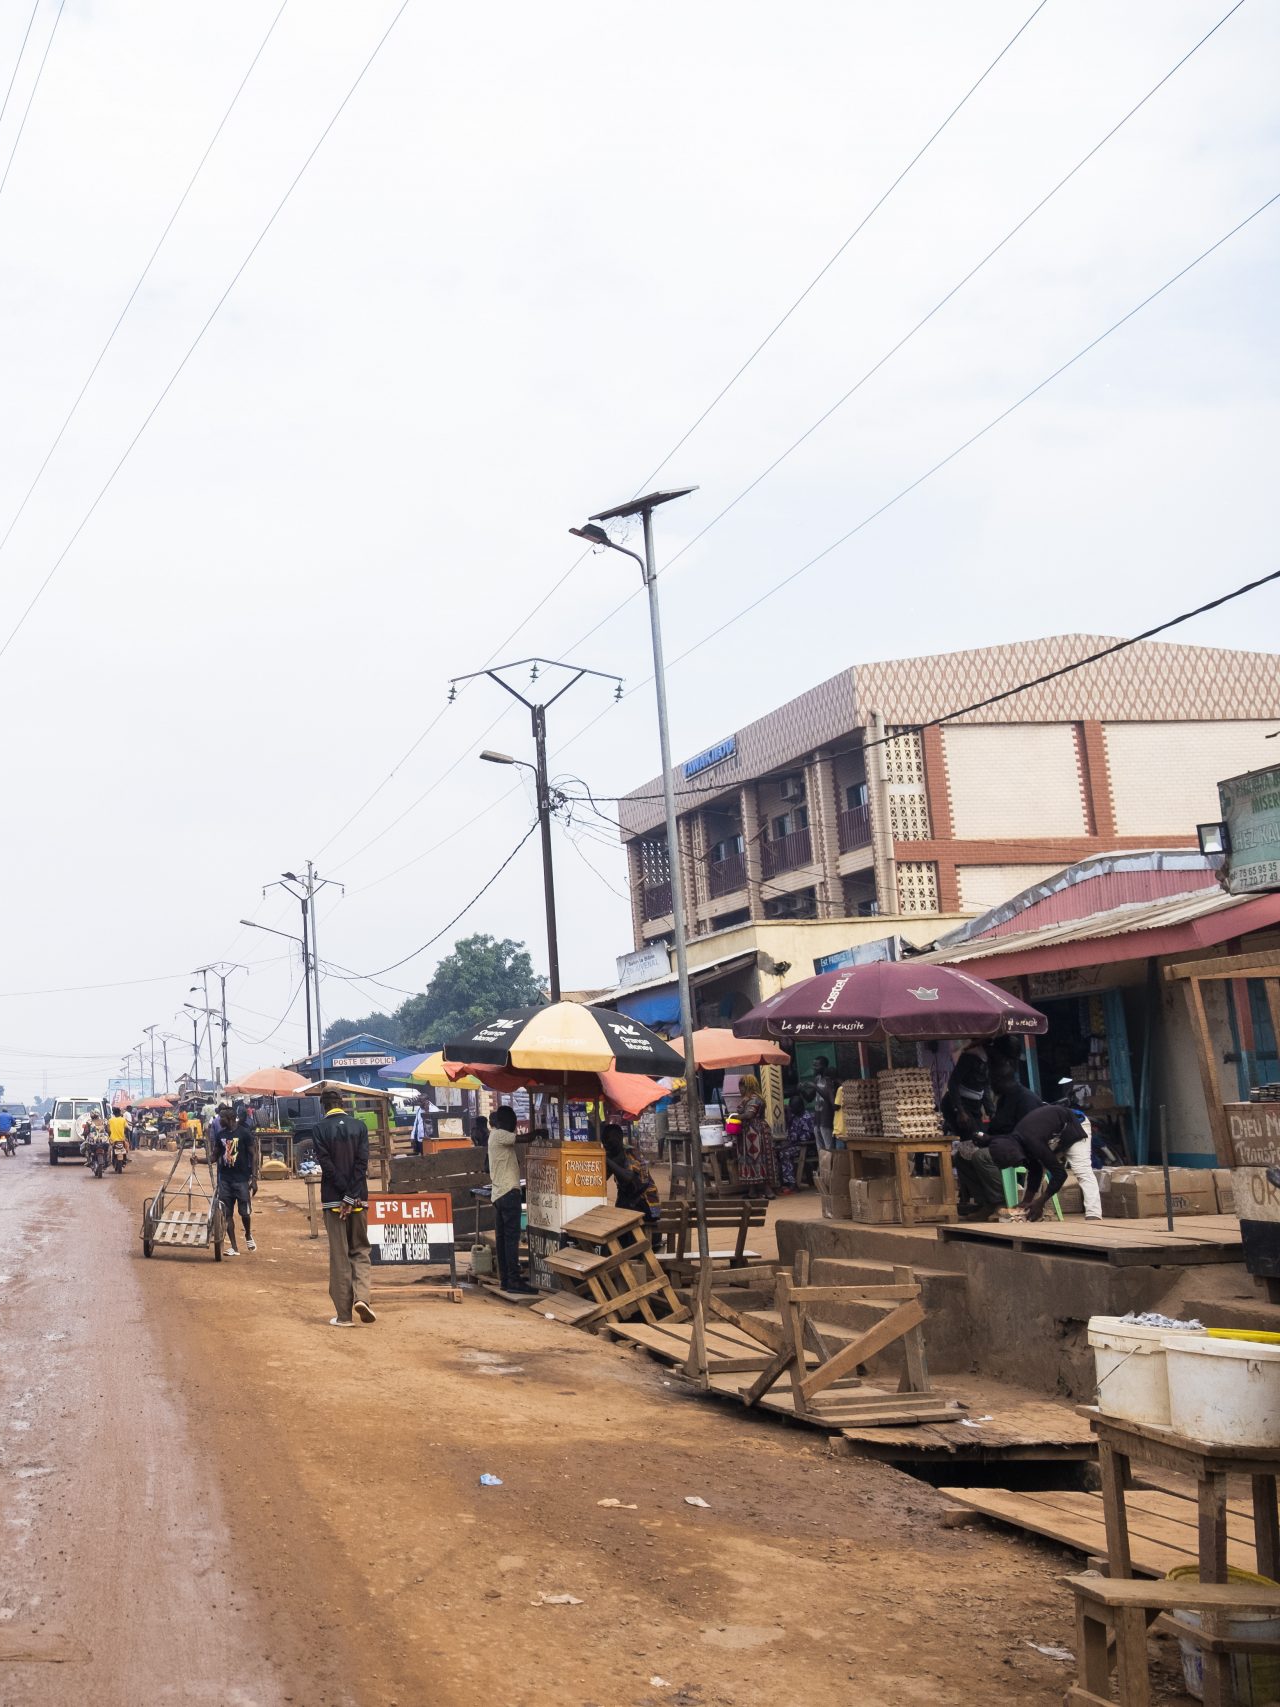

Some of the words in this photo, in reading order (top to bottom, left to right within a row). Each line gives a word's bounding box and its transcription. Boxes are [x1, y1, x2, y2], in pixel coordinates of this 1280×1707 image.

[1251, 792, 1280, 814] MISER
[1258, 864, 1267, 873] 95
[1268, 862, 1277, 871] 35
[782, 1020, 792, 1030] Le
[472, 1035, 498, 1043] Money
[619, 1036, 651, 1045] Orange
[625, 1042, 654, 1053] Money
[334, 1057, 357, 1066] POSTE
[370, 1056, 396, 1065] POLICE
[405, 1224, 412, 1243] EN
[413, 1224, 428, 1244] GROS
